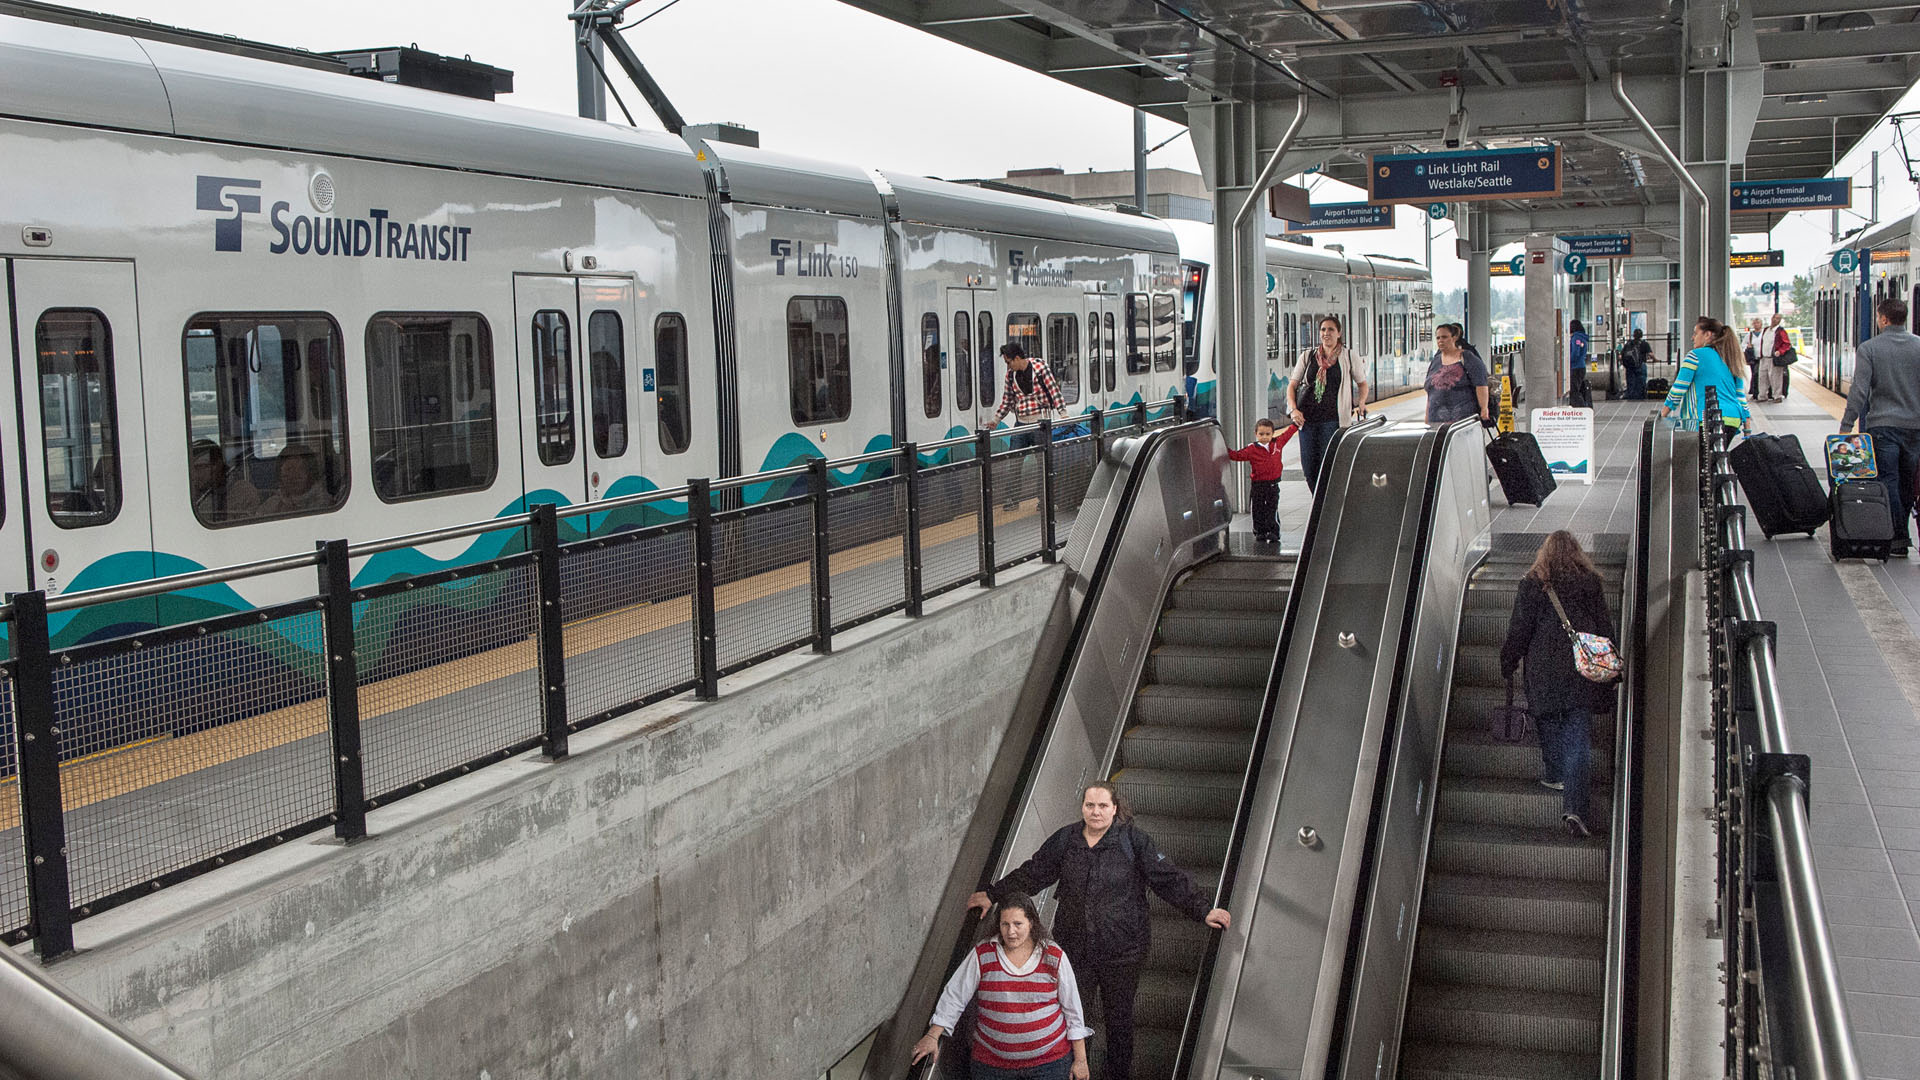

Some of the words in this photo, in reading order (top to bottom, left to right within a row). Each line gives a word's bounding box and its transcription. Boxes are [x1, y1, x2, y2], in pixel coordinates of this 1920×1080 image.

[1428, 164, 1449, 175] Link
[1452, 162, 1478, 177] Light
[1480, 160, 1500, 172] Rail
[1428, 175, 1513, 190] Westlake/Seattle
[1750, 188, 1774, 196] Airport
[1776, 186, 1805, 195] Terminal
[1750, 194, 1816, 205] Buses/International
[1817, 194, 1832, 202] Blvd
[1324, 209, 1346, 217] Airport
[1347, 207, 1373, 216] Terminal
[1360, 216, 1373, 224] Blvd
[798, 240, 833, 278] Link
[839, 256, 859, 278] 150
